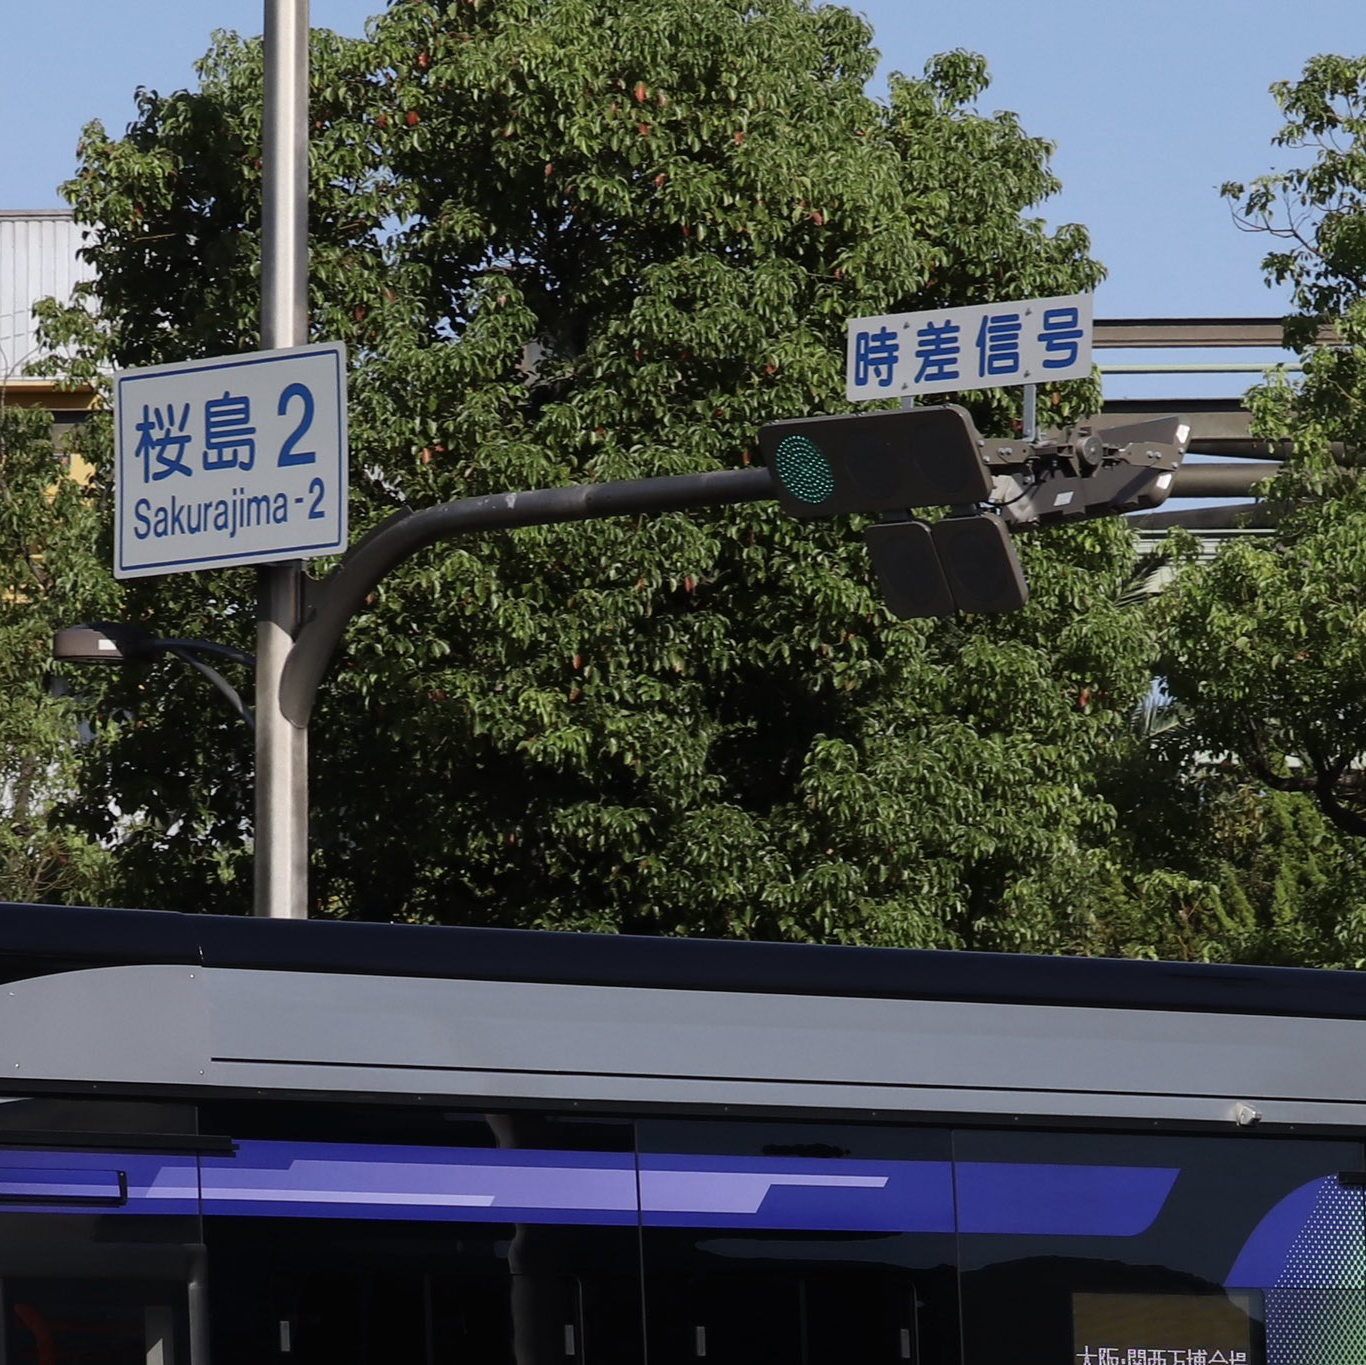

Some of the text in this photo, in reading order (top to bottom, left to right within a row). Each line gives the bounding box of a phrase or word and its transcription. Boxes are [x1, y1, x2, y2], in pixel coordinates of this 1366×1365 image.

[854, 306, 1084, 388] 時差信号
[135, 382, 316, 483] 桜島 2
